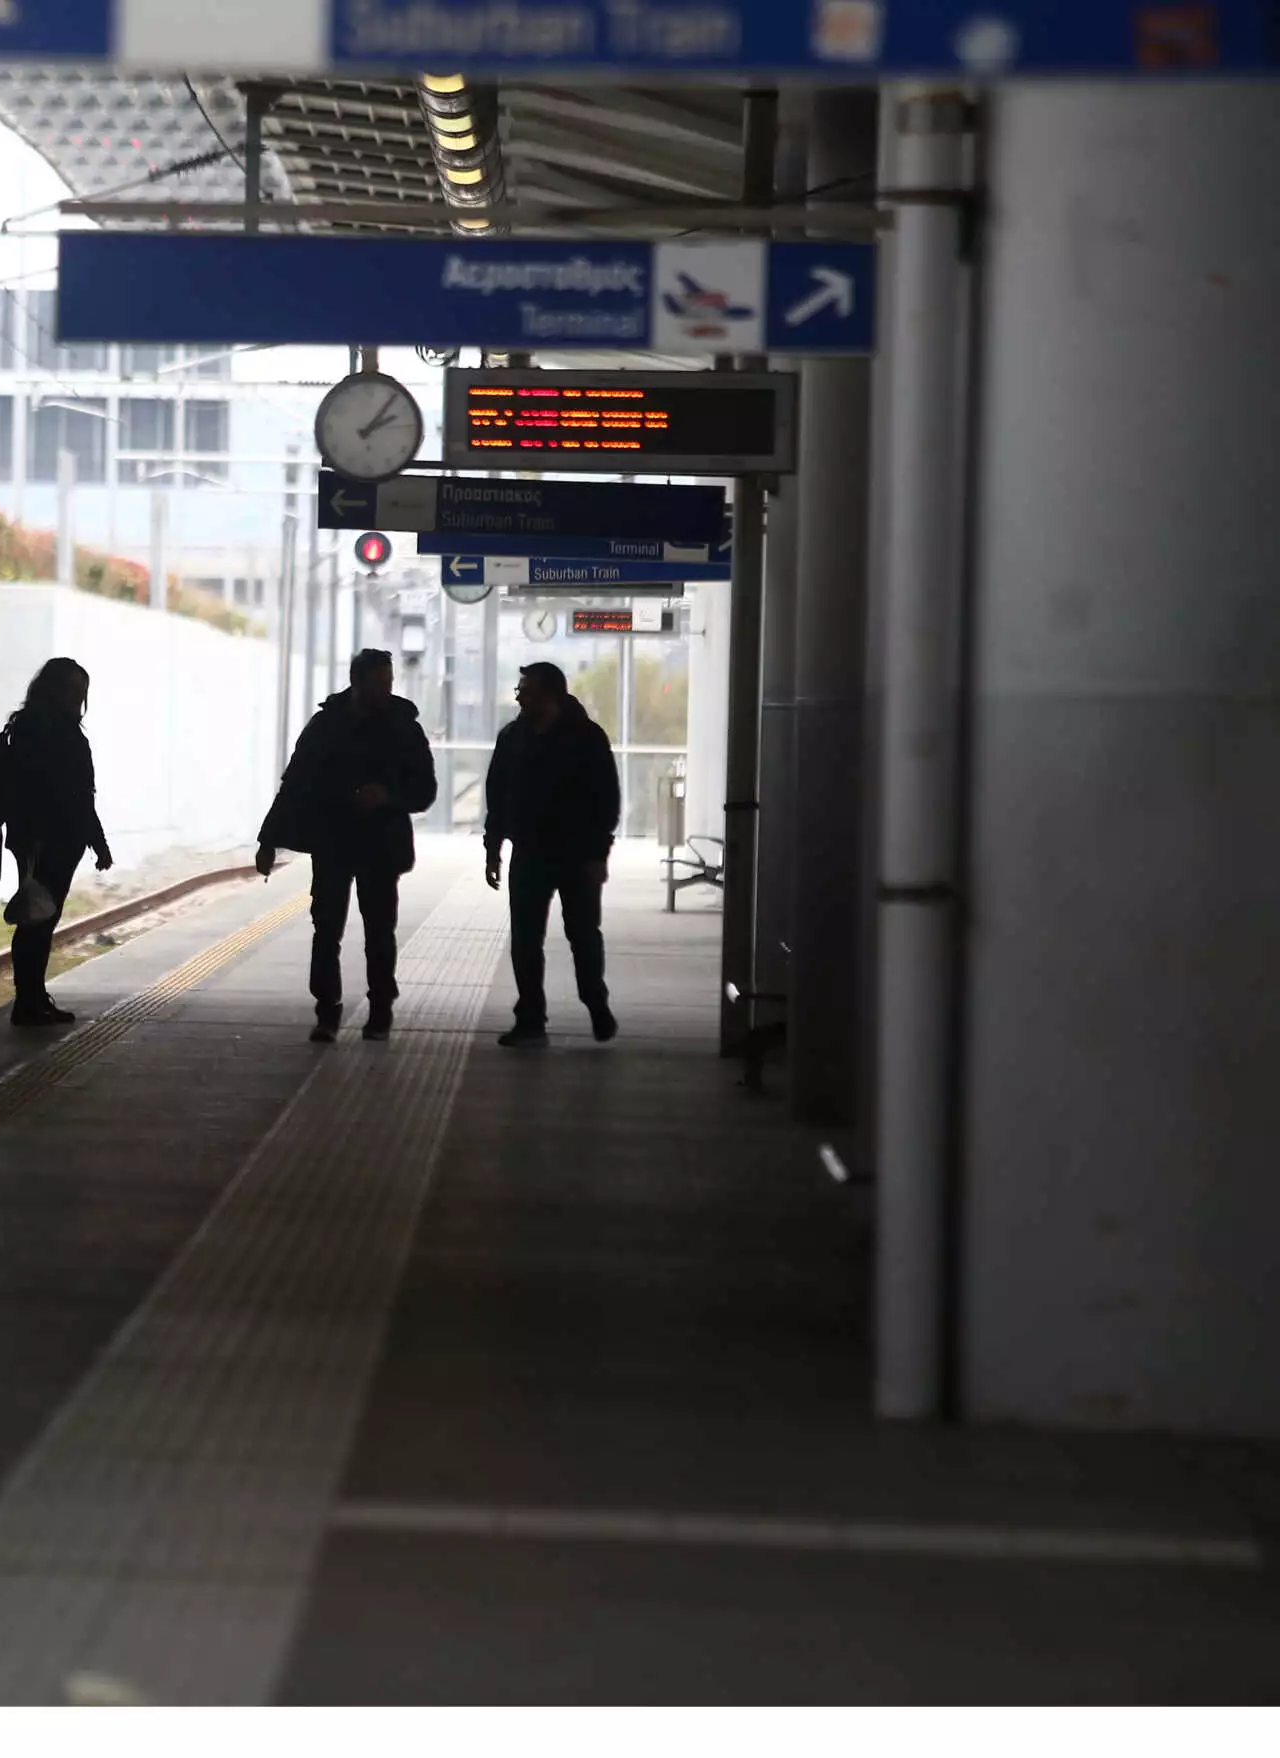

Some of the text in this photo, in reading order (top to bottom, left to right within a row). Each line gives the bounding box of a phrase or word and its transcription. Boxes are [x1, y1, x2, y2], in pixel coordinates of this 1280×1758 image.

[522, 303, 643, 337] Terminal
[442, 510, 555, 531] Suburban Train
[609, 541, 660, 557] Terminal
[533, 566, 620, 581] Suburban Train
